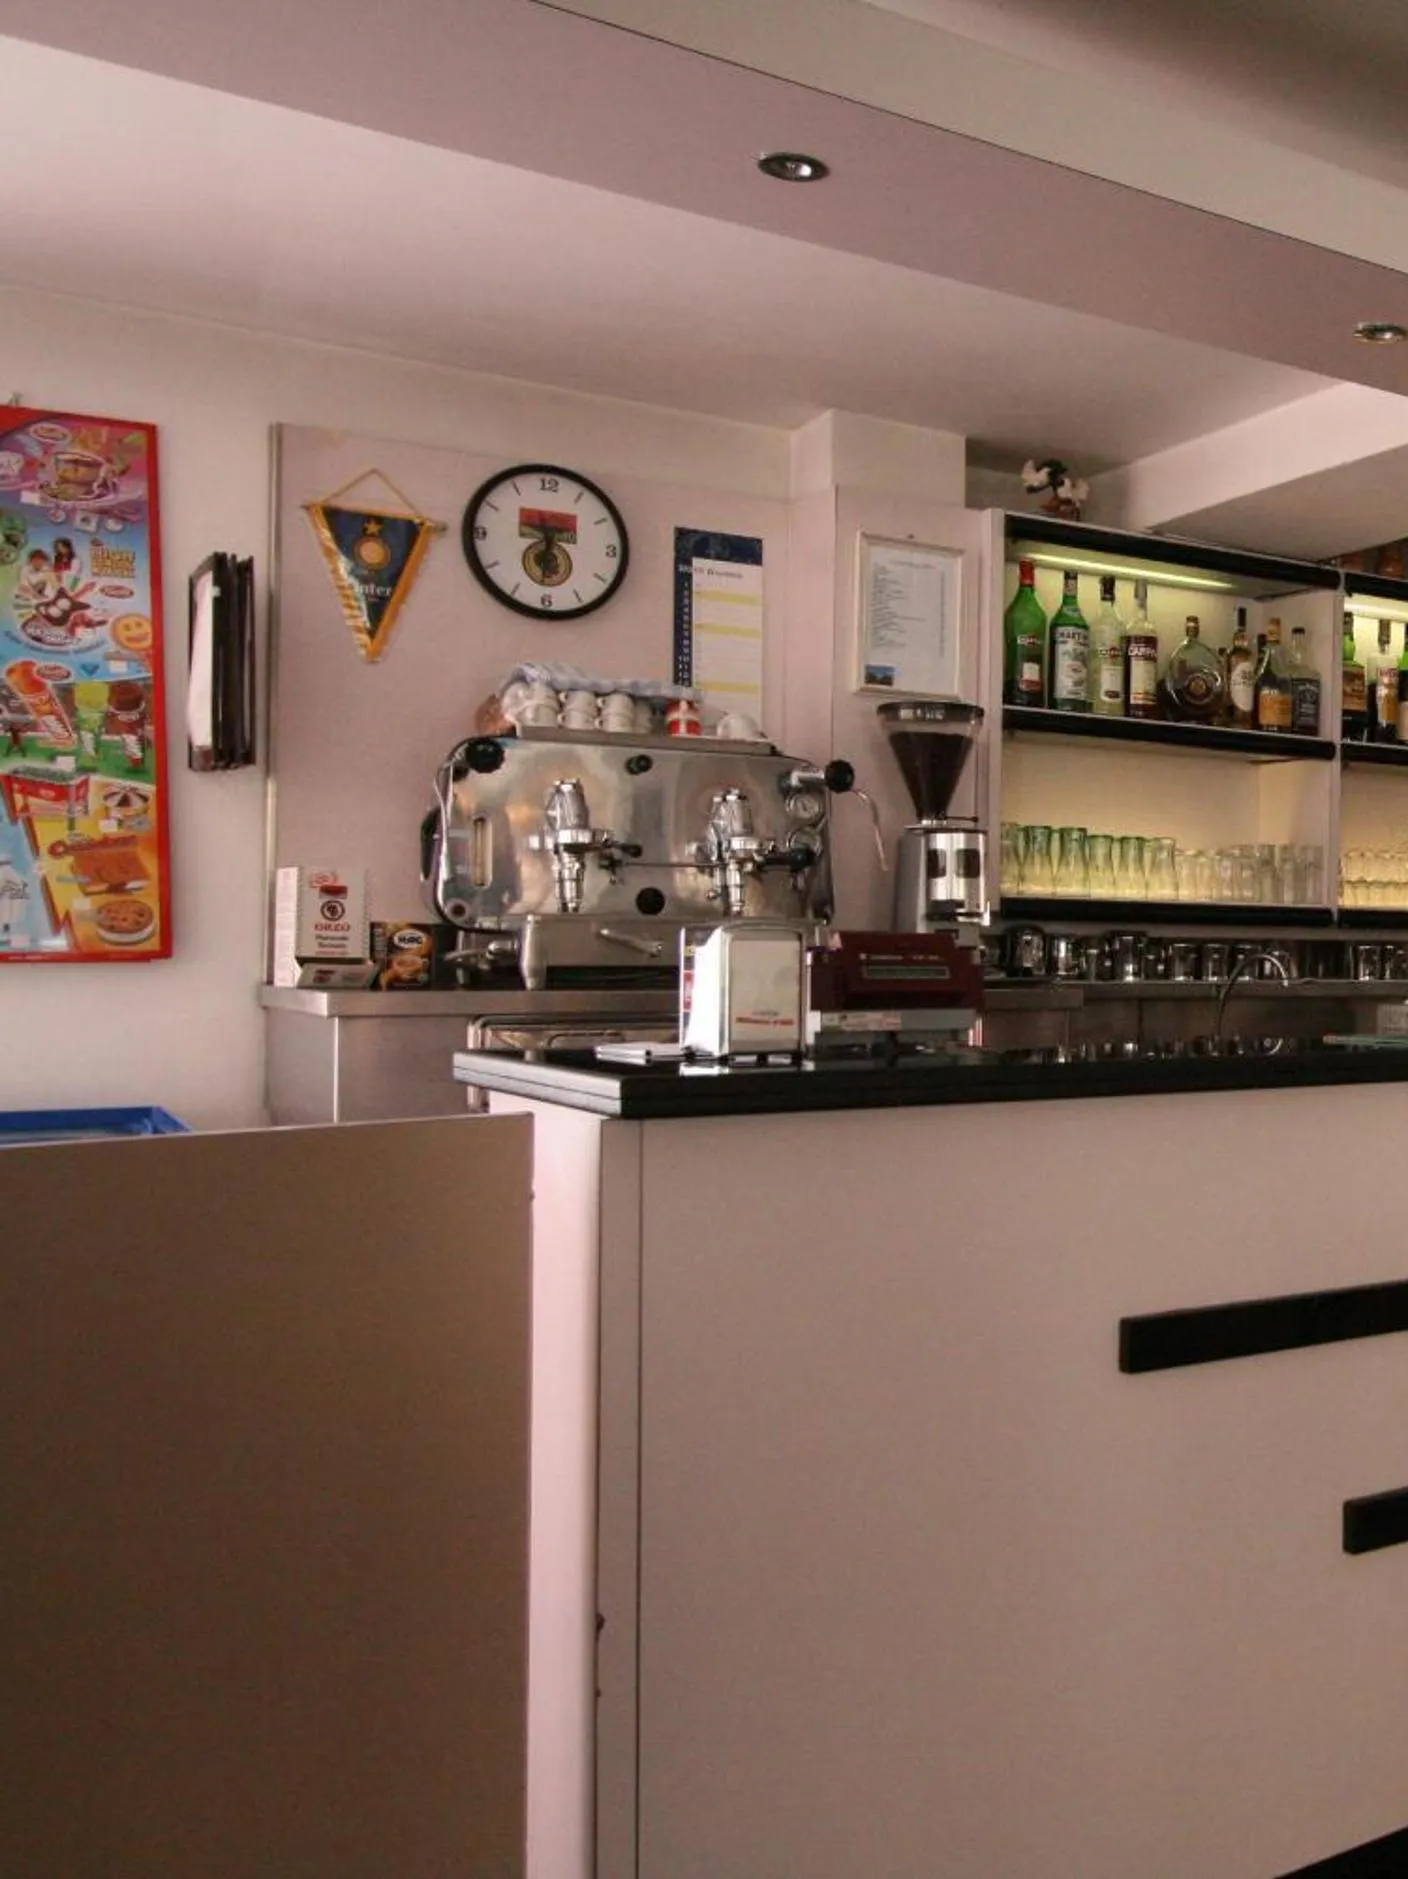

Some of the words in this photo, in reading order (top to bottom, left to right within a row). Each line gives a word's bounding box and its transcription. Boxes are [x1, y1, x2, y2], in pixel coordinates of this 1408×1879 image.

[539, 478, 560, 493] 12
[474, 526, 487, 541] 9
[605, 544, 617, 558] 3
[540, 594, 553, 609] 6
